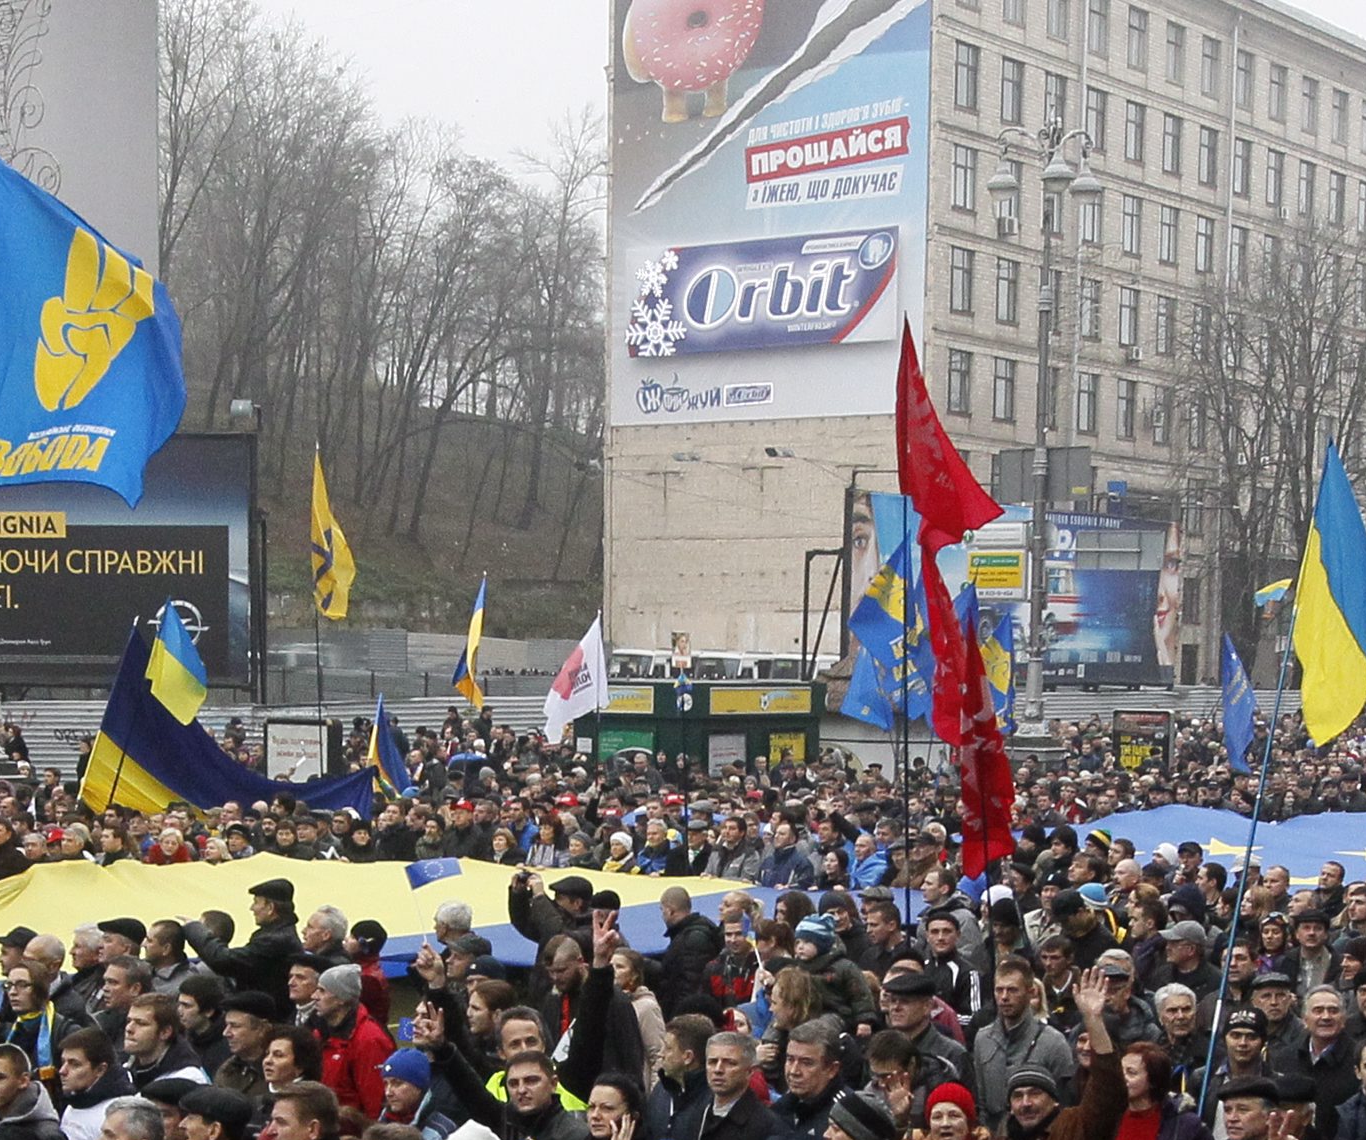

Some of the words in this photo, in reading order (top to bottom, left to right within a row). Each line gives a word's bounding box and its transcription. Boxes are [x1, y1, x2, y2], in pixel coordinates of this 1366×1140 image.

[771, 117, 812, 138] ЧИСТОТИ
[751, 125, 902, 176] ПРОЩАЙСЯ
[761, 181, 801, 204] ЇЖЕЮ,
[806, 179, 830, 202] ЩО
[831, 172, 898, 200] ДОКУЧАЄ
[685, 257, 859, 329] Orbit
[65, 549, 204, 575] СПРАВЖНІ
